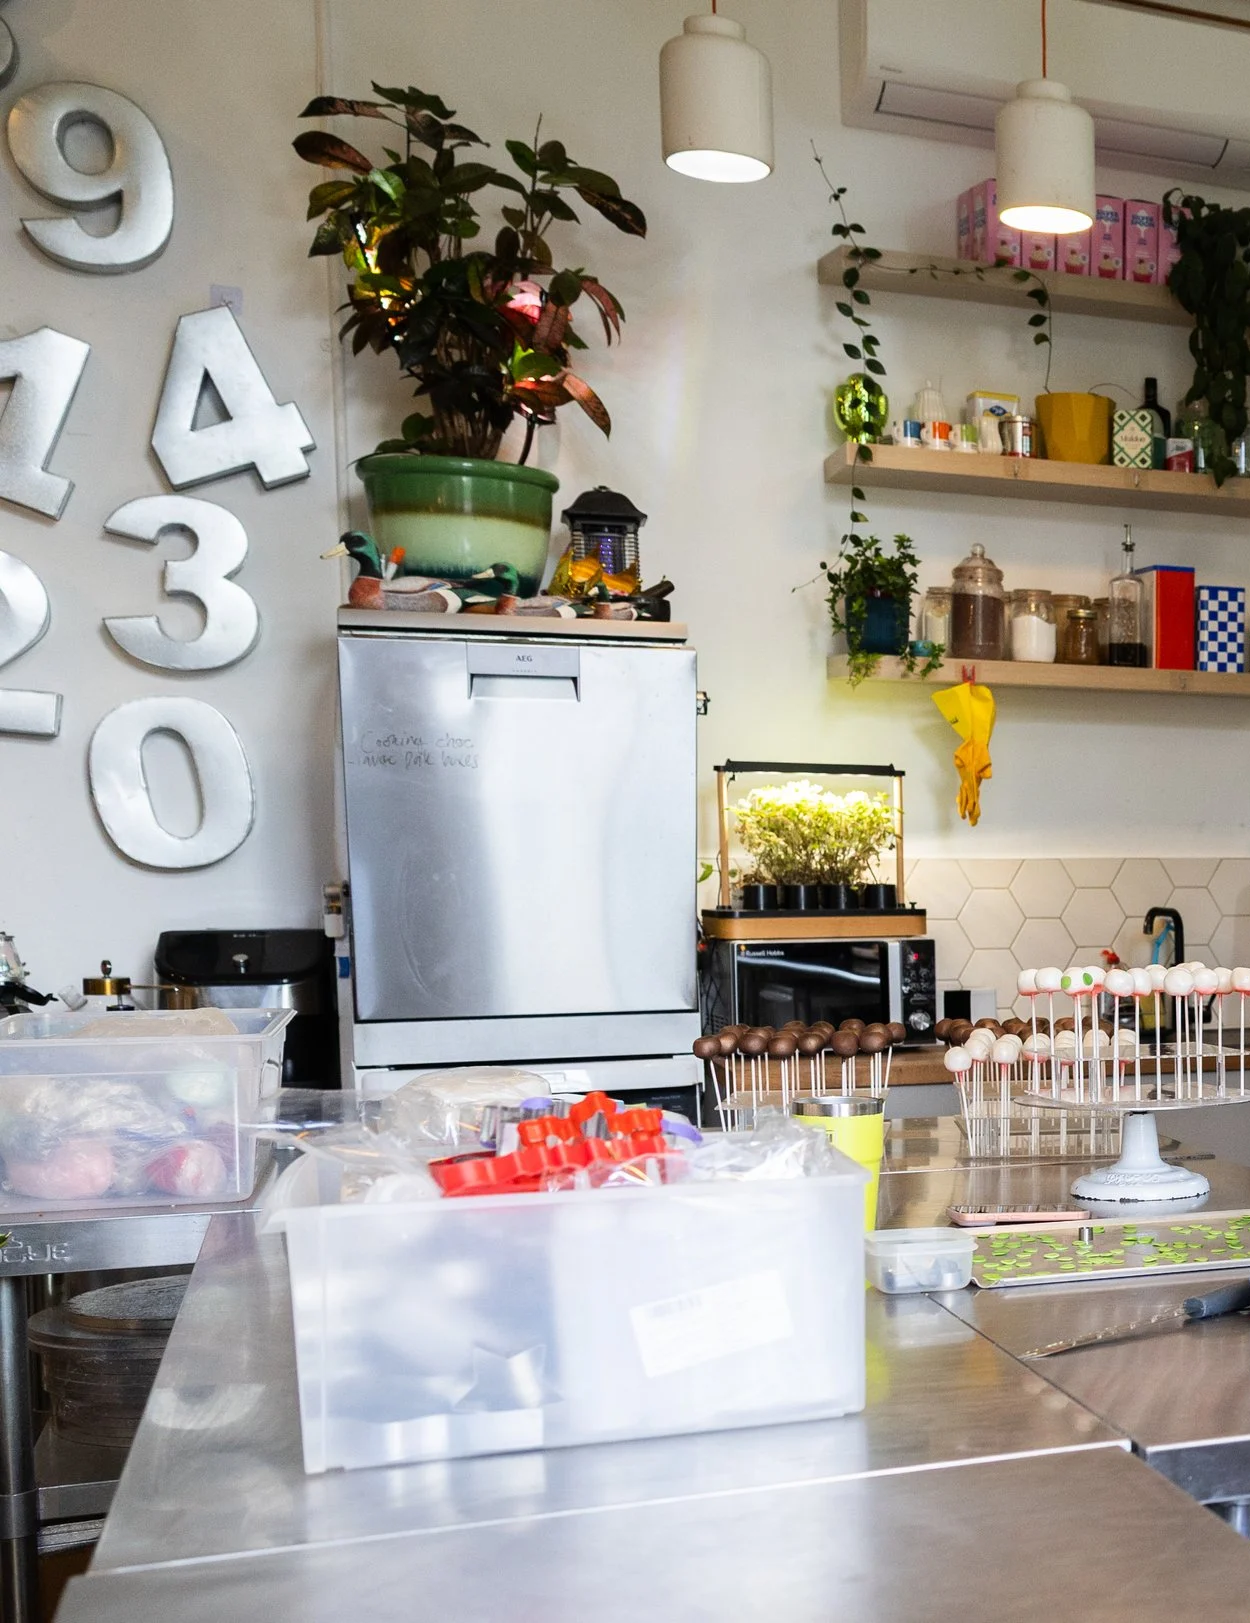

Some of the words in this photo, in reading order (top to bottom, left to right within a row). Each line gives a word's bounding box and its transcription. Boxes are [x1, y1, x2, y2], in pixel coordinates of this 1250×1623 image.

[8, 80, 174, 276] 9
[151, 303, 316, 492] 4
[103, 494, 260, 670] 3
[88, 696, 254, 870] 0
[0, 1243, 72, 1263] GUE
